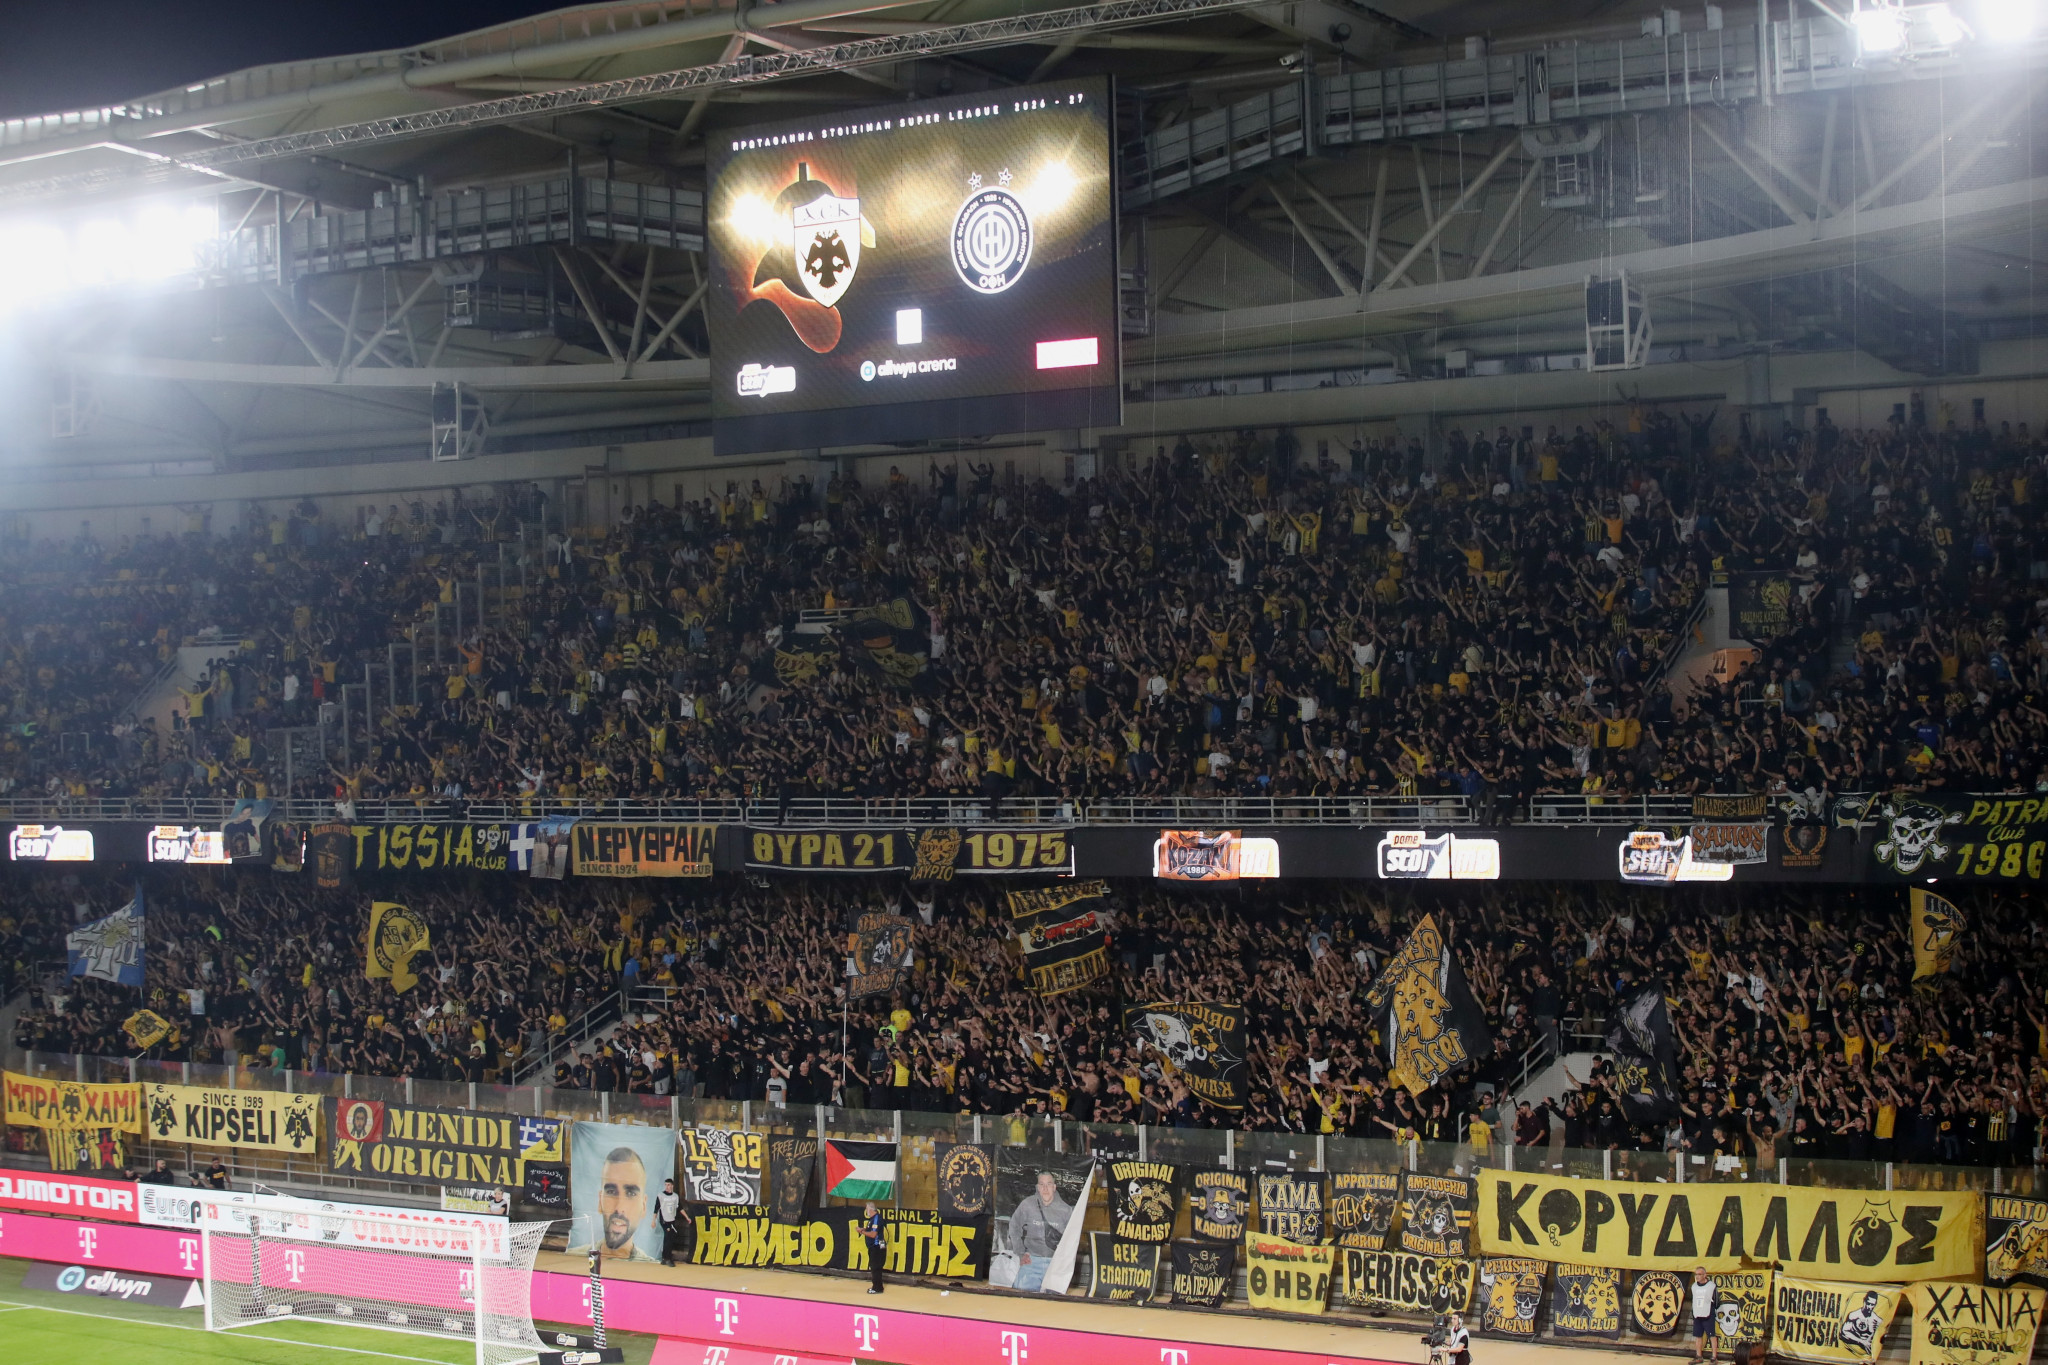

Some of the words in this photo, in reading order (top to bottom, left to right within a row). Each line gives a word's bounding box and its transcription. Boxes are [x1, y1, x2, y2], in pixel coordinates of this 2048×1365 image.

[899, 113, 940, 128] SUPER
[948, 105, 999, 121] LEAGUE
[918, 358, 957, 373] arena
[753, 832, 846, 866] ΘΥΡΑ
[854, 833, 894, 866] 21
[966, 832, 1067, 867] 1975
[1692, 826, 1764, 853] SAMOS
[475, 856, 506, 871] CLUB
[580, 864, 612, 874] SINCE
[614, 864, 638, 875] 1974
[681, 863, 712, 875] CLUB
[85, 1089, 137, 1123] ΧΑΜΙ
[202, 1092, 237, 1107] SINCE
[243, 1095, 264, 1109] 1989
[186, 1103, 276, 1144] KIPSELI
[387, 1108, 512, 1150] MENIDI
[684, 1130, 718, 1172] LA
[731, 1134, 761, 1169] 82
[772, 1140, 795, 1162] FREE
[794, 1141, 817, 1159] LOCO
[1111, 1161, 1175, 1184] ORIGINAL
[1195, 1172, 1248, 1194] ORIGINAL
[1260, 1182, 1322, 1212] KAMA
[1407, 1175, 1468, 1198] AMFILOCHIA
[708, 1206, 749, 1216] ΓΝΗΣΙΑ
[1336, 1197, 1363, 1228] ΑΕΚ
[1990, 1196, 2048, 1223] KIATO
[692, 1215, 834, 1267] ΗΡΑΚΛΕΙΟ
[848, 1219, 977, 1277] ΚΗΤΗΣ
[1402, 1235, 1448, 1256] ORIGINAL
[1450, 1240, 1464, 1255] 21
[1311, 1247, 1329, 1265] 21
[1485, 1260, 1549, 1275] PERISTERI
[85, 1270, 152, 1299] allwyn
[1557, 1264, 1606, 1279] ORIGINAL
[1608, 1268, 1620, 1282] 21
[1640, 1271, 1681, 1290] STUTTGART
[1922, 1284, 2039, 1332] ΧΑΝΙΑ
[1556, 1312, 1589, 1330] LAMIA
[1589, 1317, 1618, 1331] CLUB
[1777, 1315, 1840, 1348] PATISSIA
